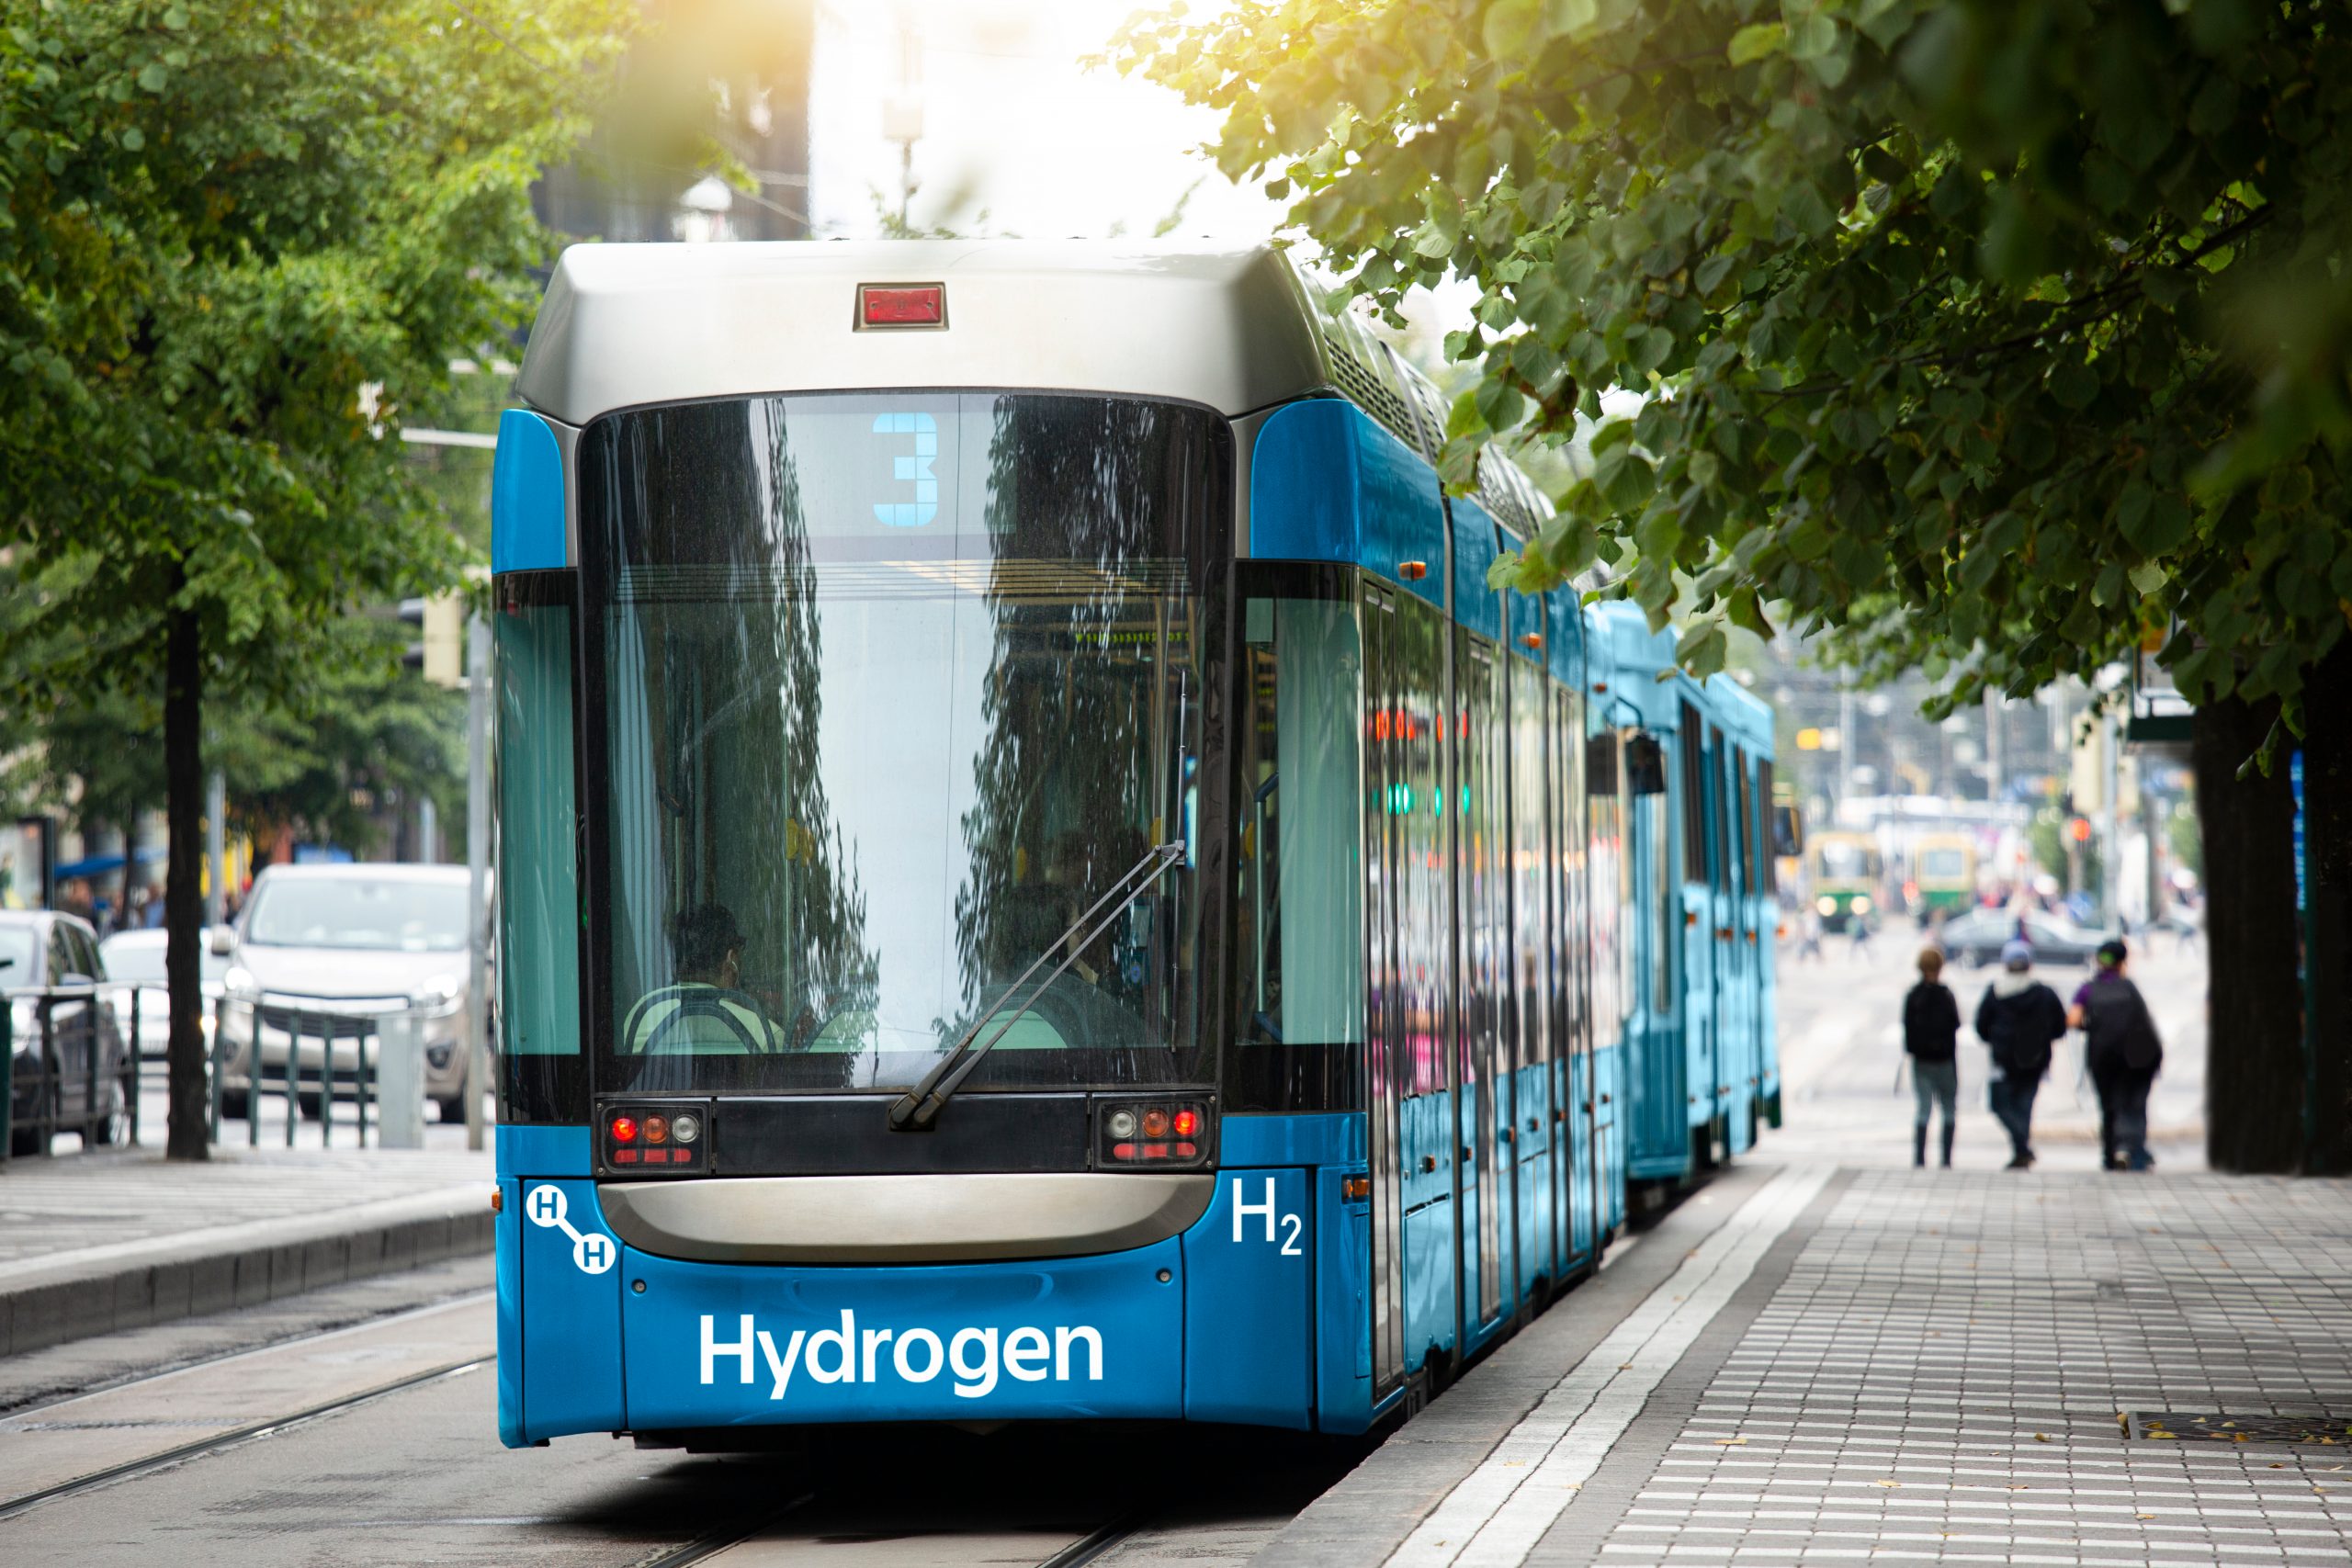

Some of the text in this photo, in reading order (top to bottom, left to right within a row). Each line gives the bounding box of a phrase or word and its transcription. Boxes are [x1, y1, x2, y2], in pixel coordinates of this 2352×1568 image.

[873, 412, 938, 527] 3
[536, 1191, 558, 1220] H
[582, 1241, 605, 1268] H
[700, 1309, 1103, 1400] Hydrogen
